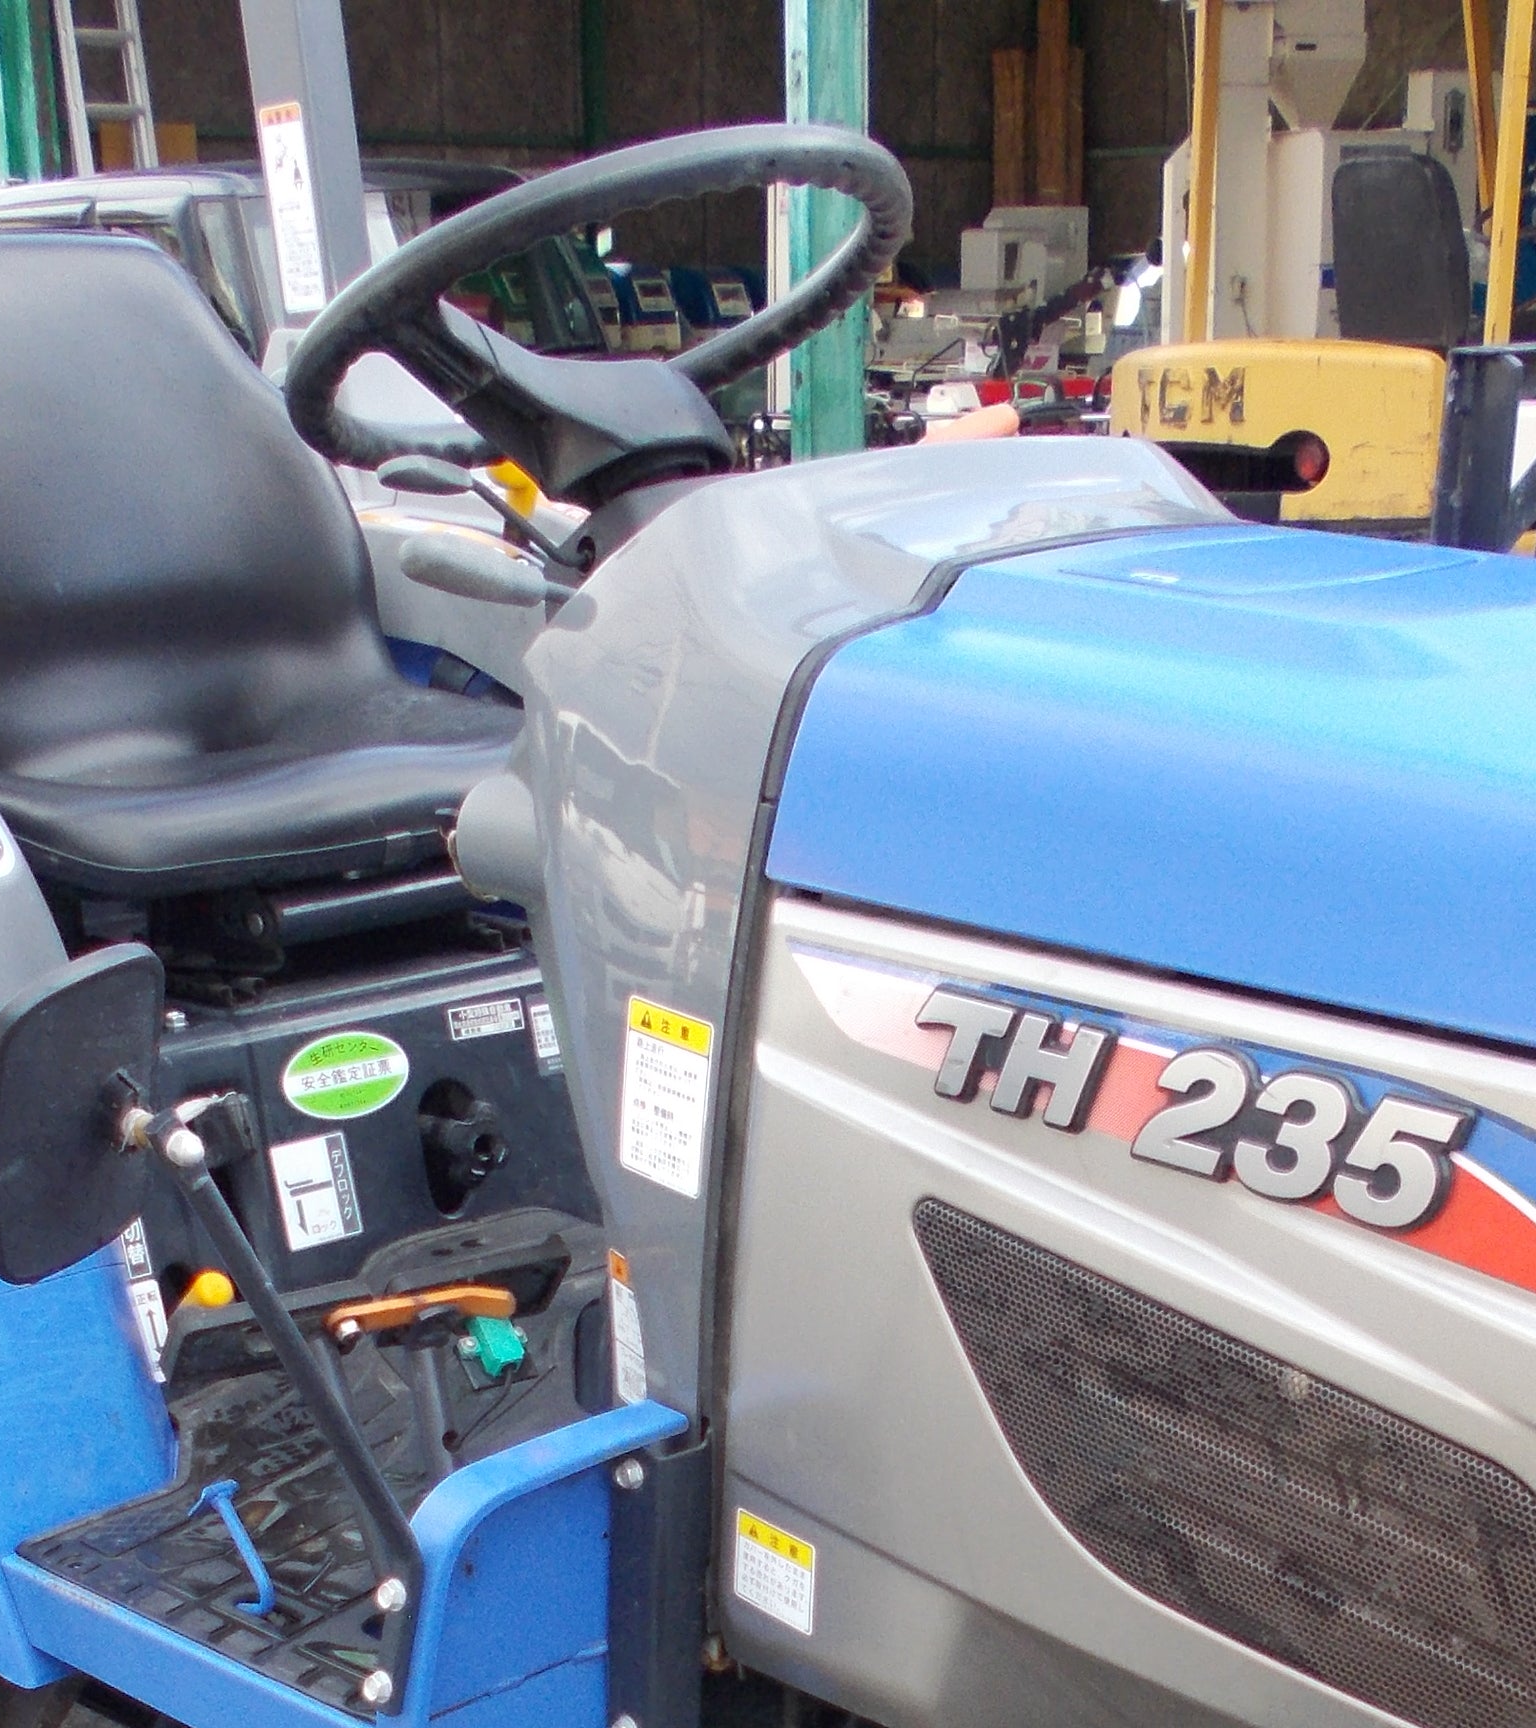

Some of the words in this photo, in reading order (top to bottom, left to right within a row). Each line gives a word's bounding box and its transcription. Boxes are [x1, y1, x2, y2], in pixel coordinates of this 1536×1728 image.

[309, 1041, 379, 1067] 生研センター
[301, 1058, 393, 1091] 安全鑑定証票
[914, 984, 1116, 1134] TH
[1129, 1045, 1478, 1232] 235
